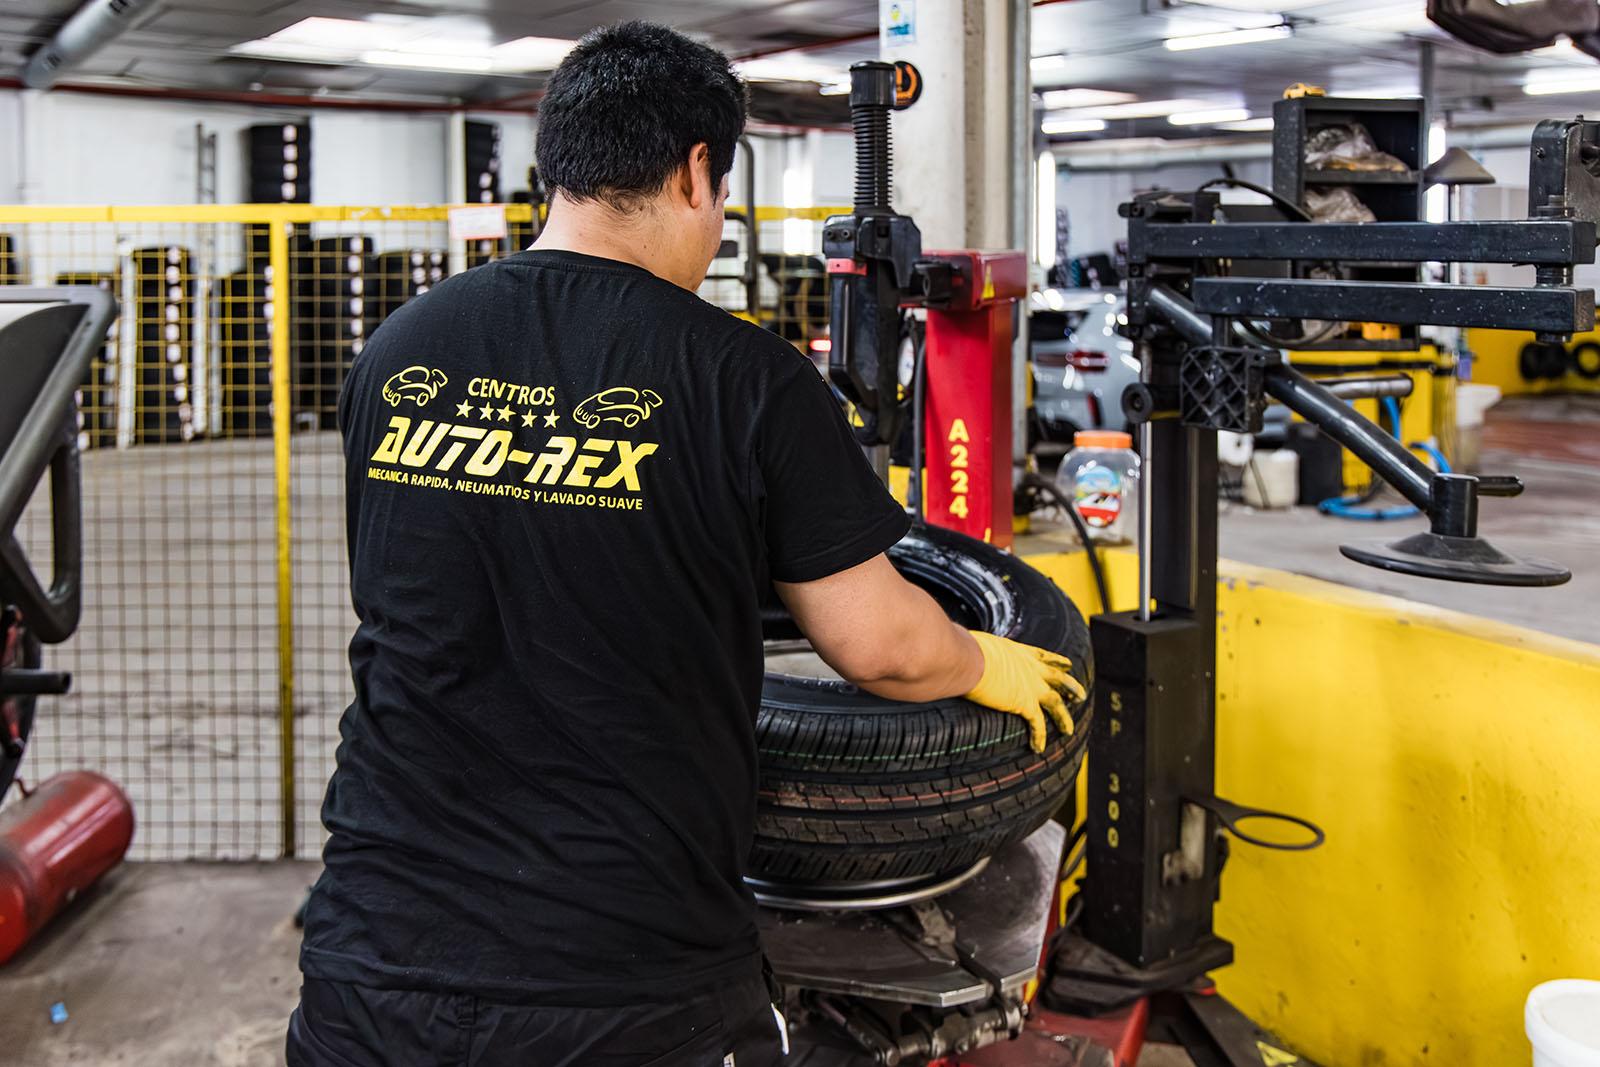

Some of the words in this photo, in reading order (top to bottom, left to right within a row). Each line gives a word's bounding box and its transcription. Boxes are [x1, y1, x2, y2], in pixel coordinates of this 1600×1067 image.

[467, 377, 556, 407] CENTROS
[370, 415, 660, 492] AUTO-REX
[410, 473, 454, 491] RAPIDA,
[455, 479, 531, 500] NEUMATIOS
[533, 490, 543, 503] Y
[543, 491, 597, 507] LAVADO
[598, 495, 643, 510] SUAVE
[948, 418, 970, 519] A224
[1107, 772, 1120, 849] 300
